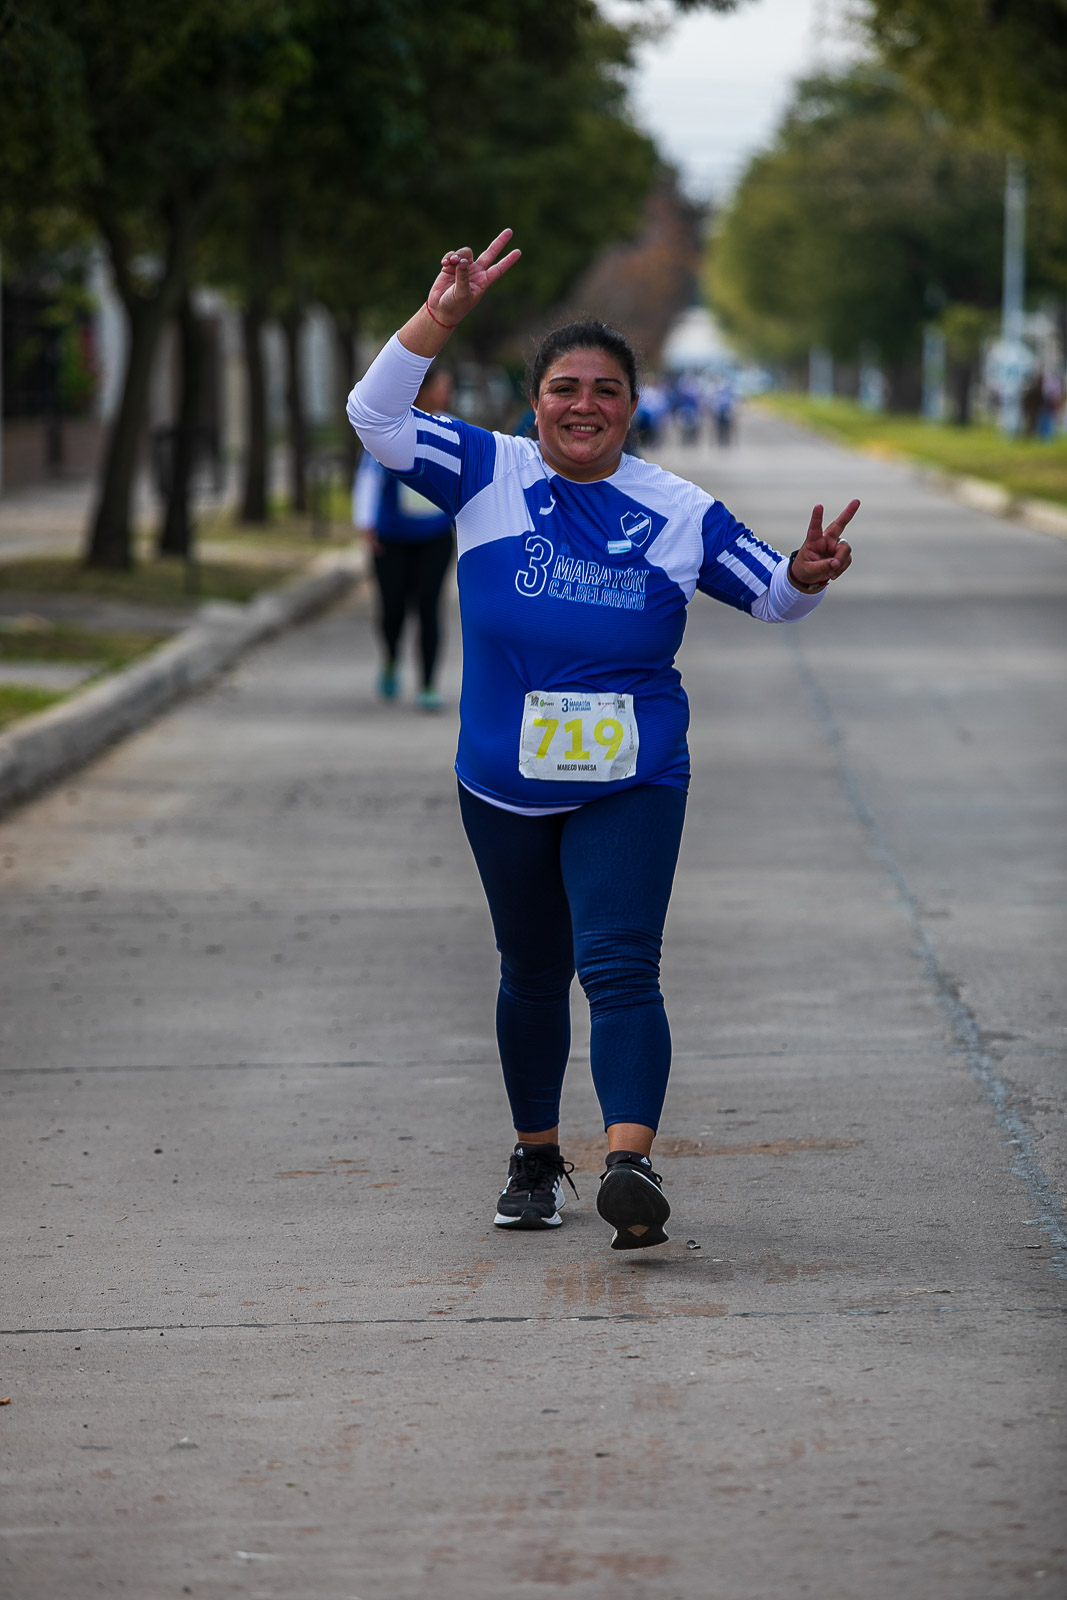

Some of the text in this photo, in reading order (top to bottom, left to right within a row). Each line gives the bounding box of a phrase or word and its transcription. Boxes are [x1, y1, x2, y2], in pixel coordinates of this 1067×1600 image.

[515, 535, 650, 597] 3 MARATÓN
[561, 697, 569, 712] 3
[533, 717, 624, 760] 719
[557, 763, 577, 771] MARECO
